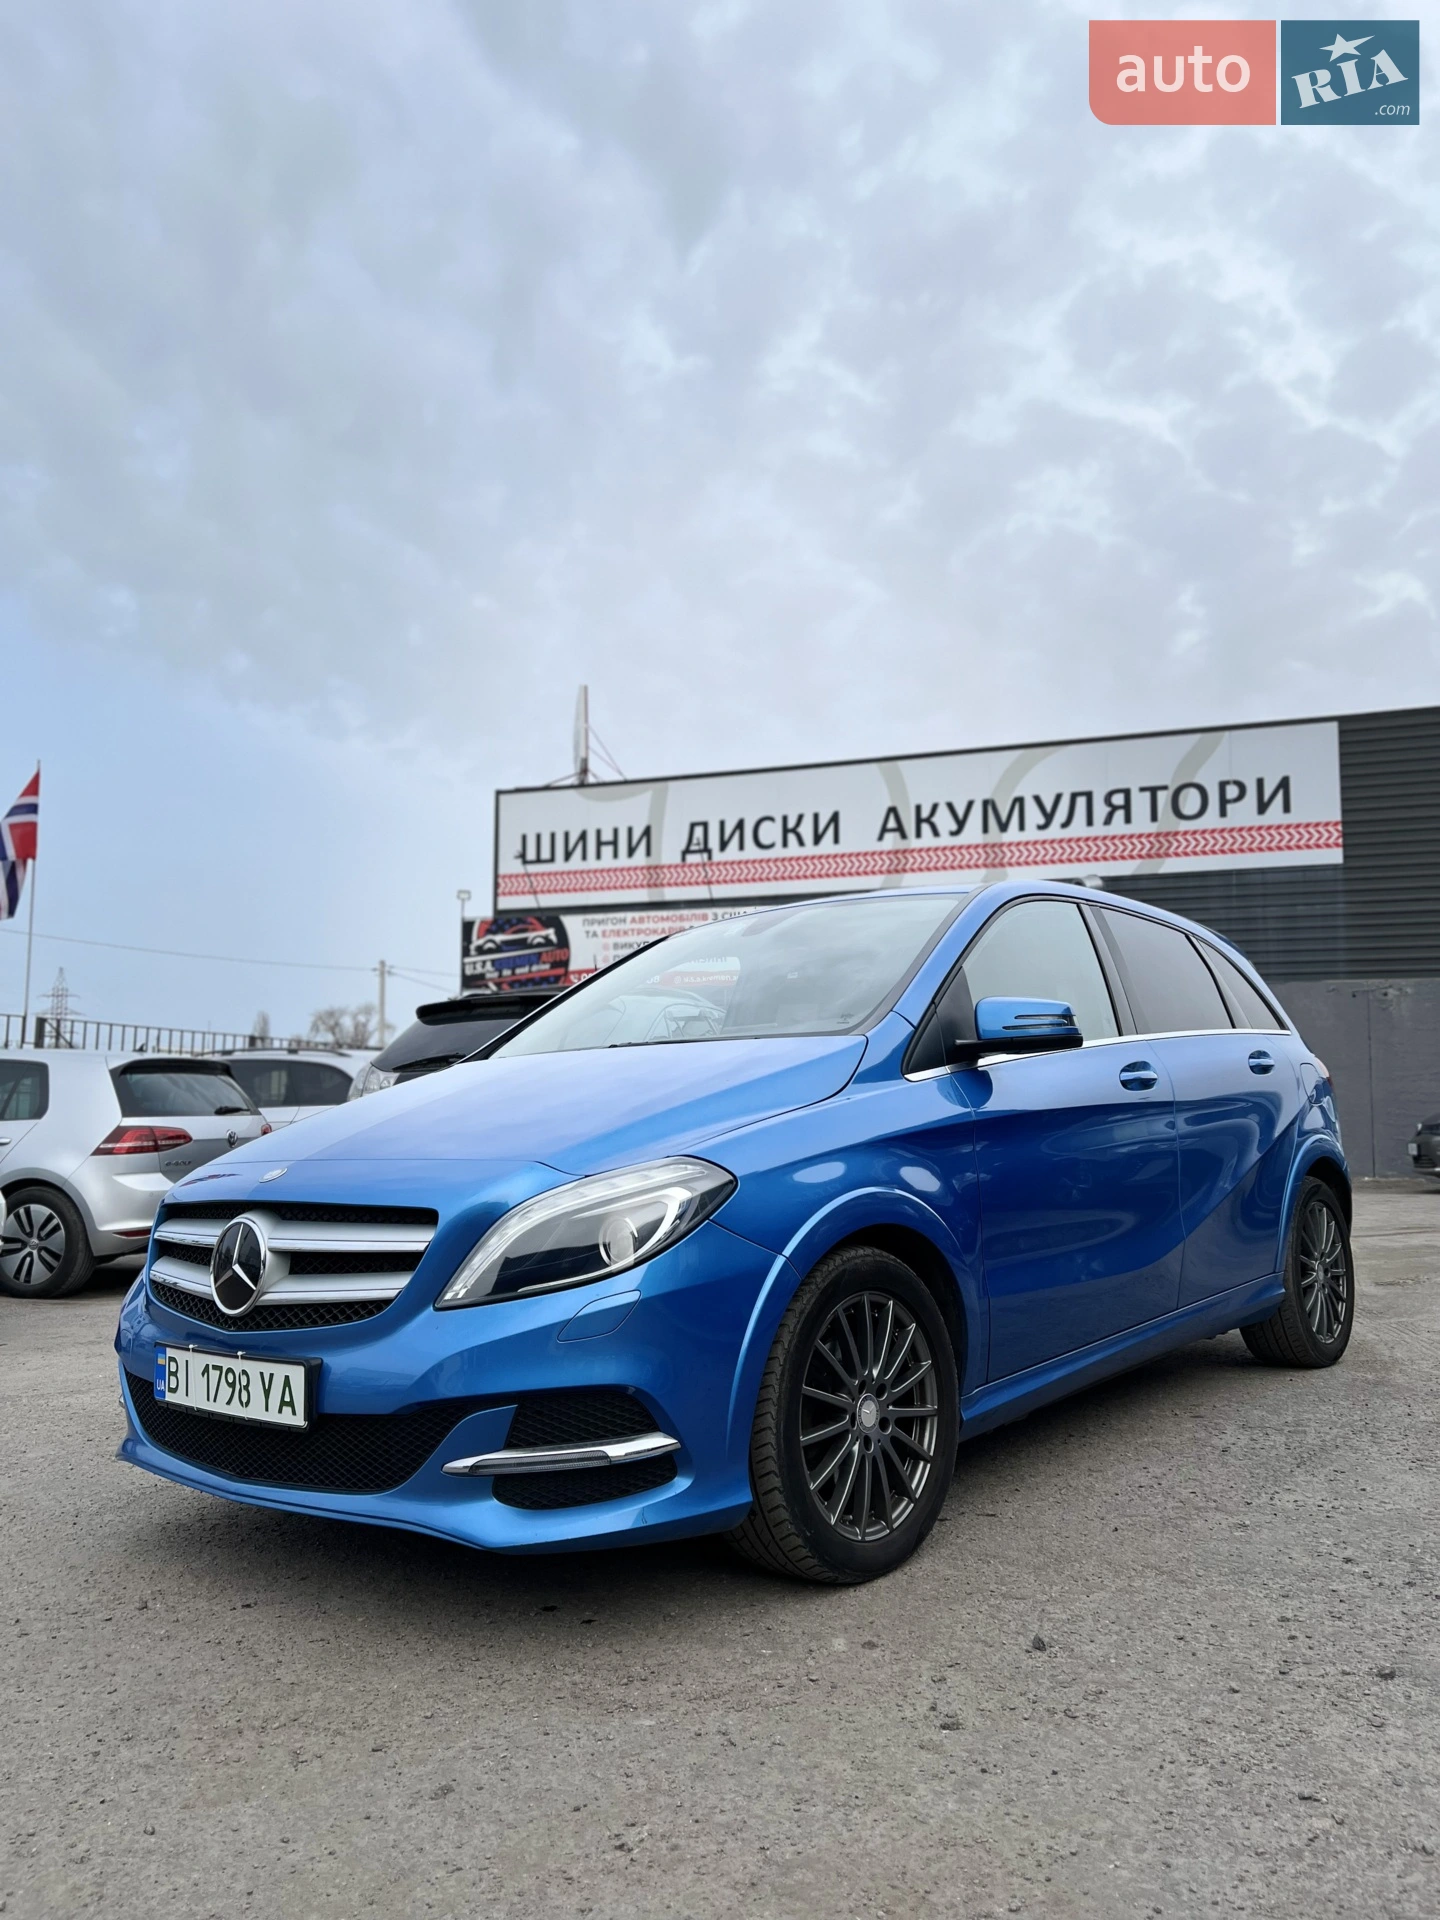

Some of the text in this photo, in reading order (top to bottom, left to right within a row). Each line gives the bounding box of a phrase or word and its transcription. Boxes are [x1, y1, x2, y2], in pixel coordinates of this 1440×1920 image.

[520, 775, 1292, 865] ШИНИ ДИСКИ АКУМУЛЯТОРИ
[582, 916, 627, 927] ПРИГОН
[629, 911, 709, 925] АВТОМОБІЛІВ
[585, 930, 599, 939] ТА
[541, 948, 570, 963] AUTO
[156, 1379, 165, 1392] UA
[167, 1356, 297, 1417] BI 1798 YA
